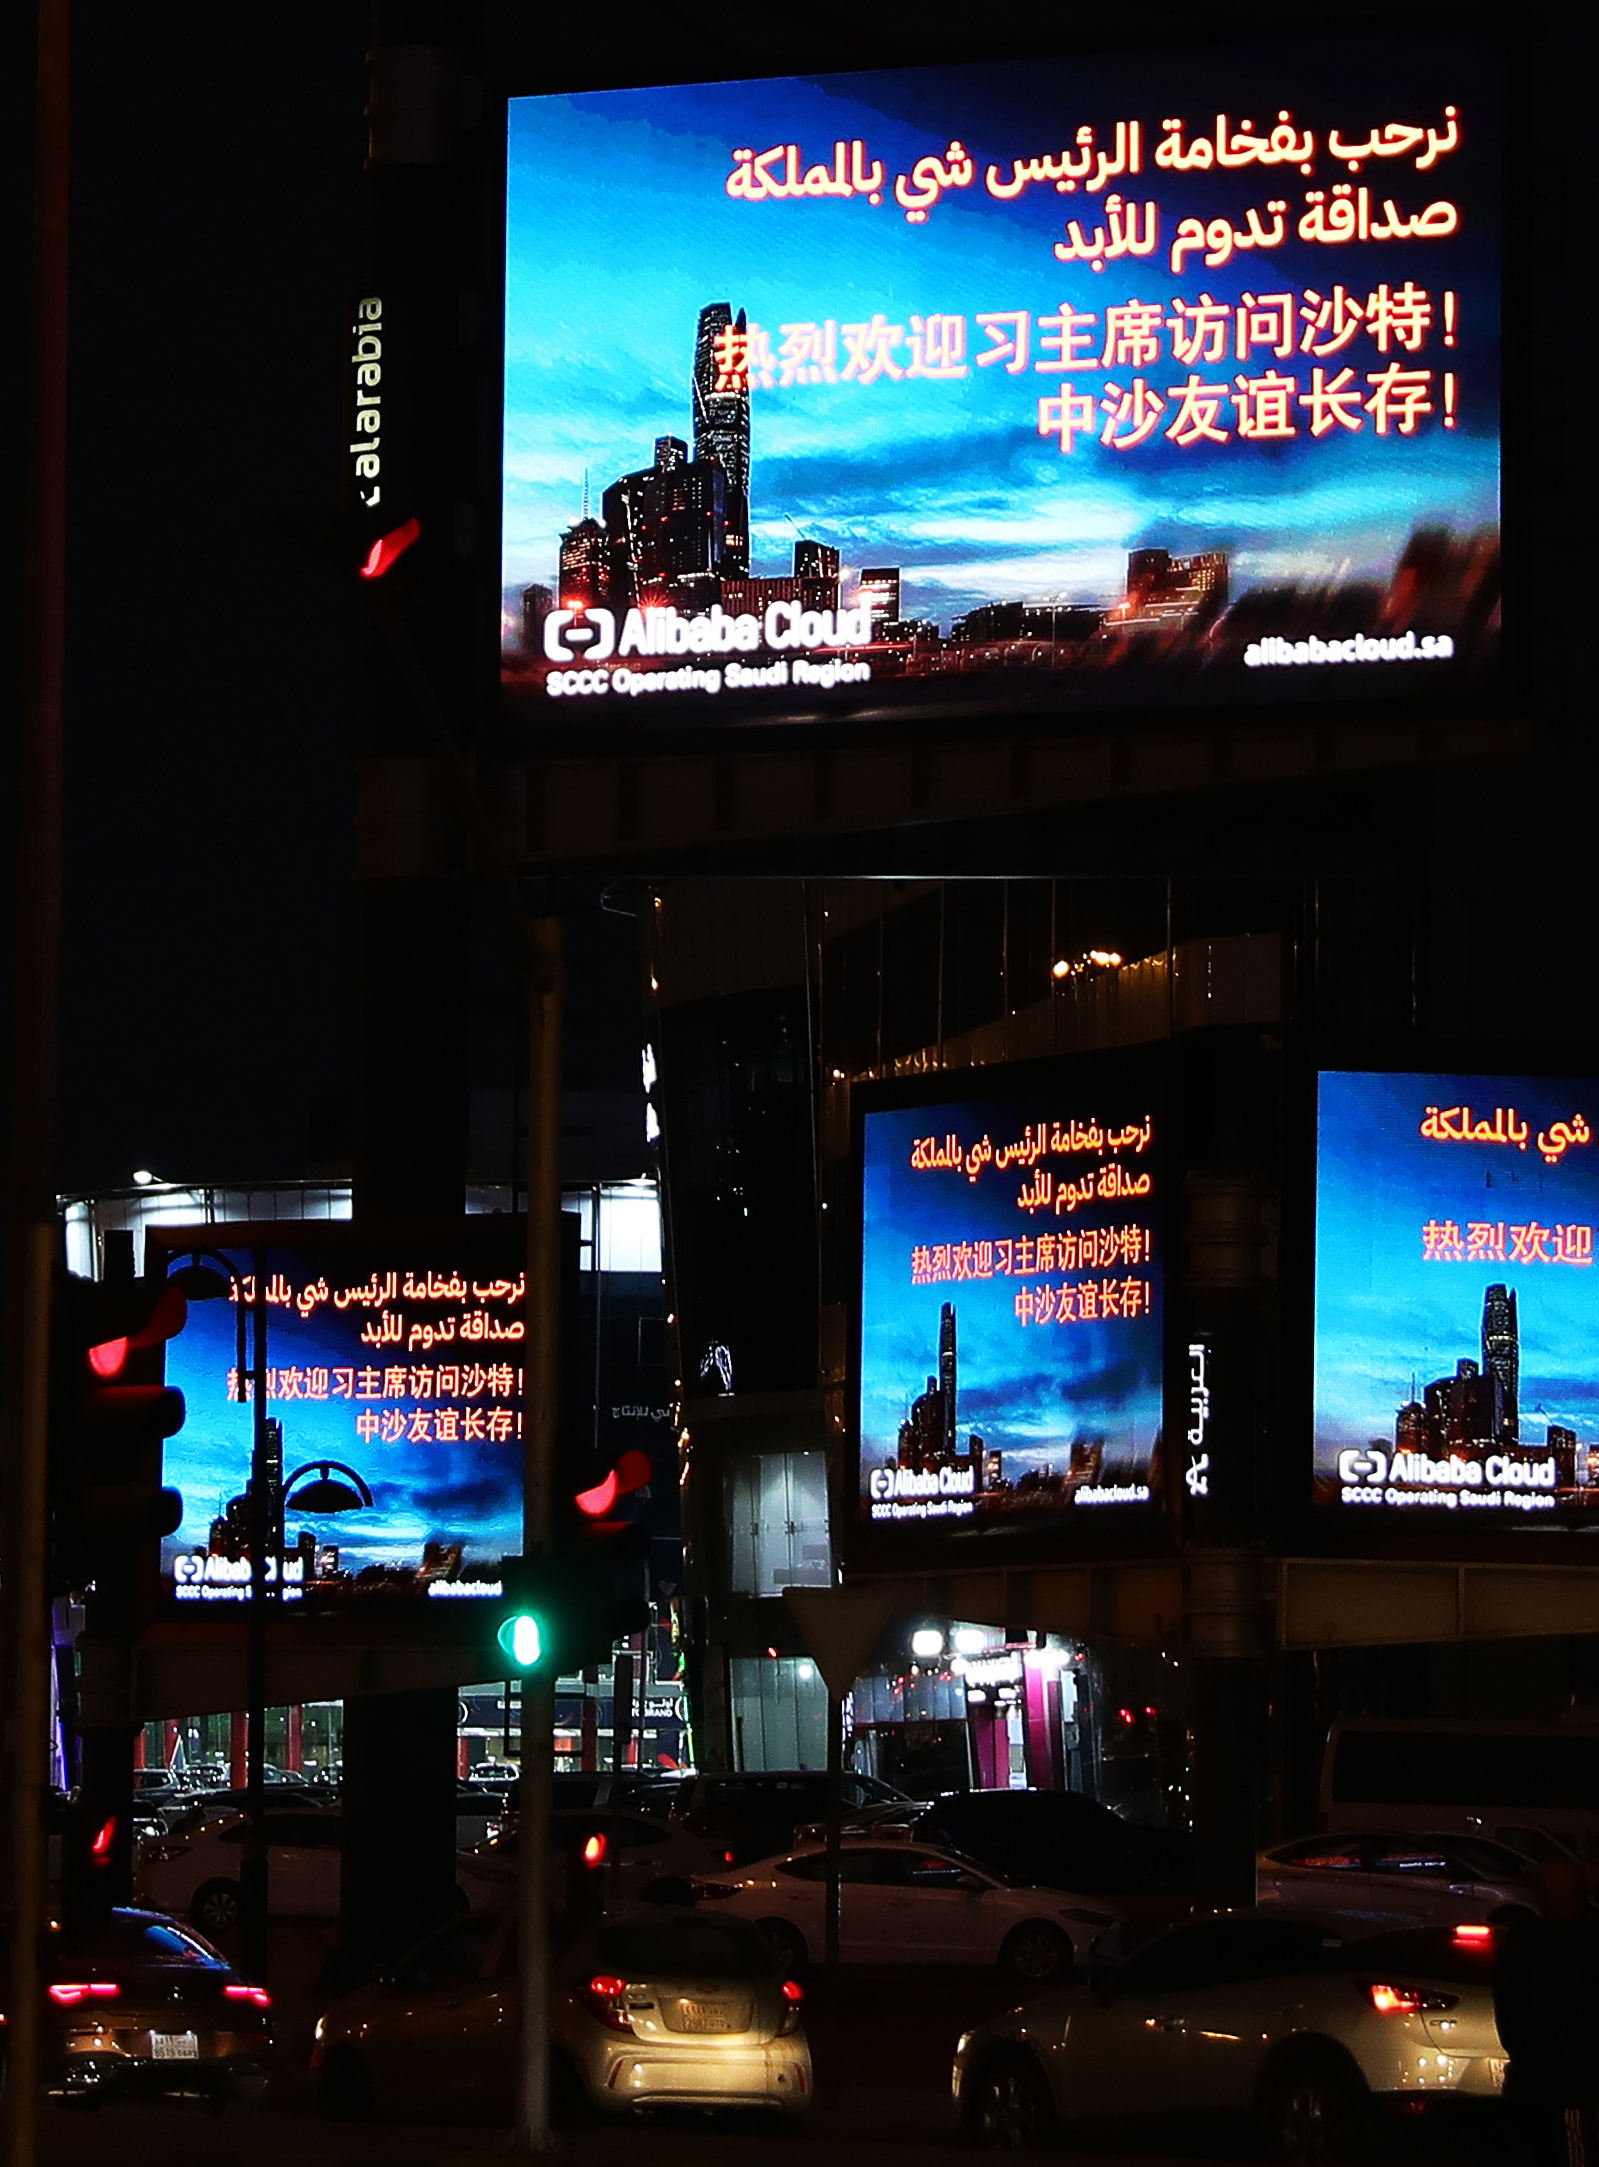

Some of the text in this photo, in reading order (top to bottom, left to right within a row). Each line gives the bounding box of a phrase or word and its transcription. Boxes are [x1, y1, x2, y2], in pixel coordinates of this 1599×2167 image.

[725, 105, 1460, 225] نرحب بفخامة الرئيس شي بالمملكة
[1053, 183, 1458, 275] صداقة تدوم للأبد
[350, 297, 382, 479] alarabia
[618, 599, 872, 656] Alibaba Cloud
[1244, 630, 1454, 667] alibabacloud.sa
[546, 658, 872, 697] SCCC Operating Saudi Region
[910, 1114, 1152, 1183] نرحب بفخامة الرئيس شي بالمملكة
[1419, 1106, 1591, 1164] شي بالمملكة
[1017, 1162, 1151, 1216] صداقة تدوم للأبد
[296, 1276, 329, 1318] شي
[333, 1271, 398, 1309] الرئيس
[402, 1270, 467, 1304] بفخامة
[472, 1272, 526, 1305] نرحب
[360, 1309, 525, 1352] صداقة تدوم للأبد
[895, 1465, 974, 1497] Alibaba Cloud
[1389, 1452, 1556, 1487] Alibaba Cloud
[1341, 1486, 1556, 1511] SCCC Operating Saudi Region
[204, 1555, 252, 1582] Alibab
